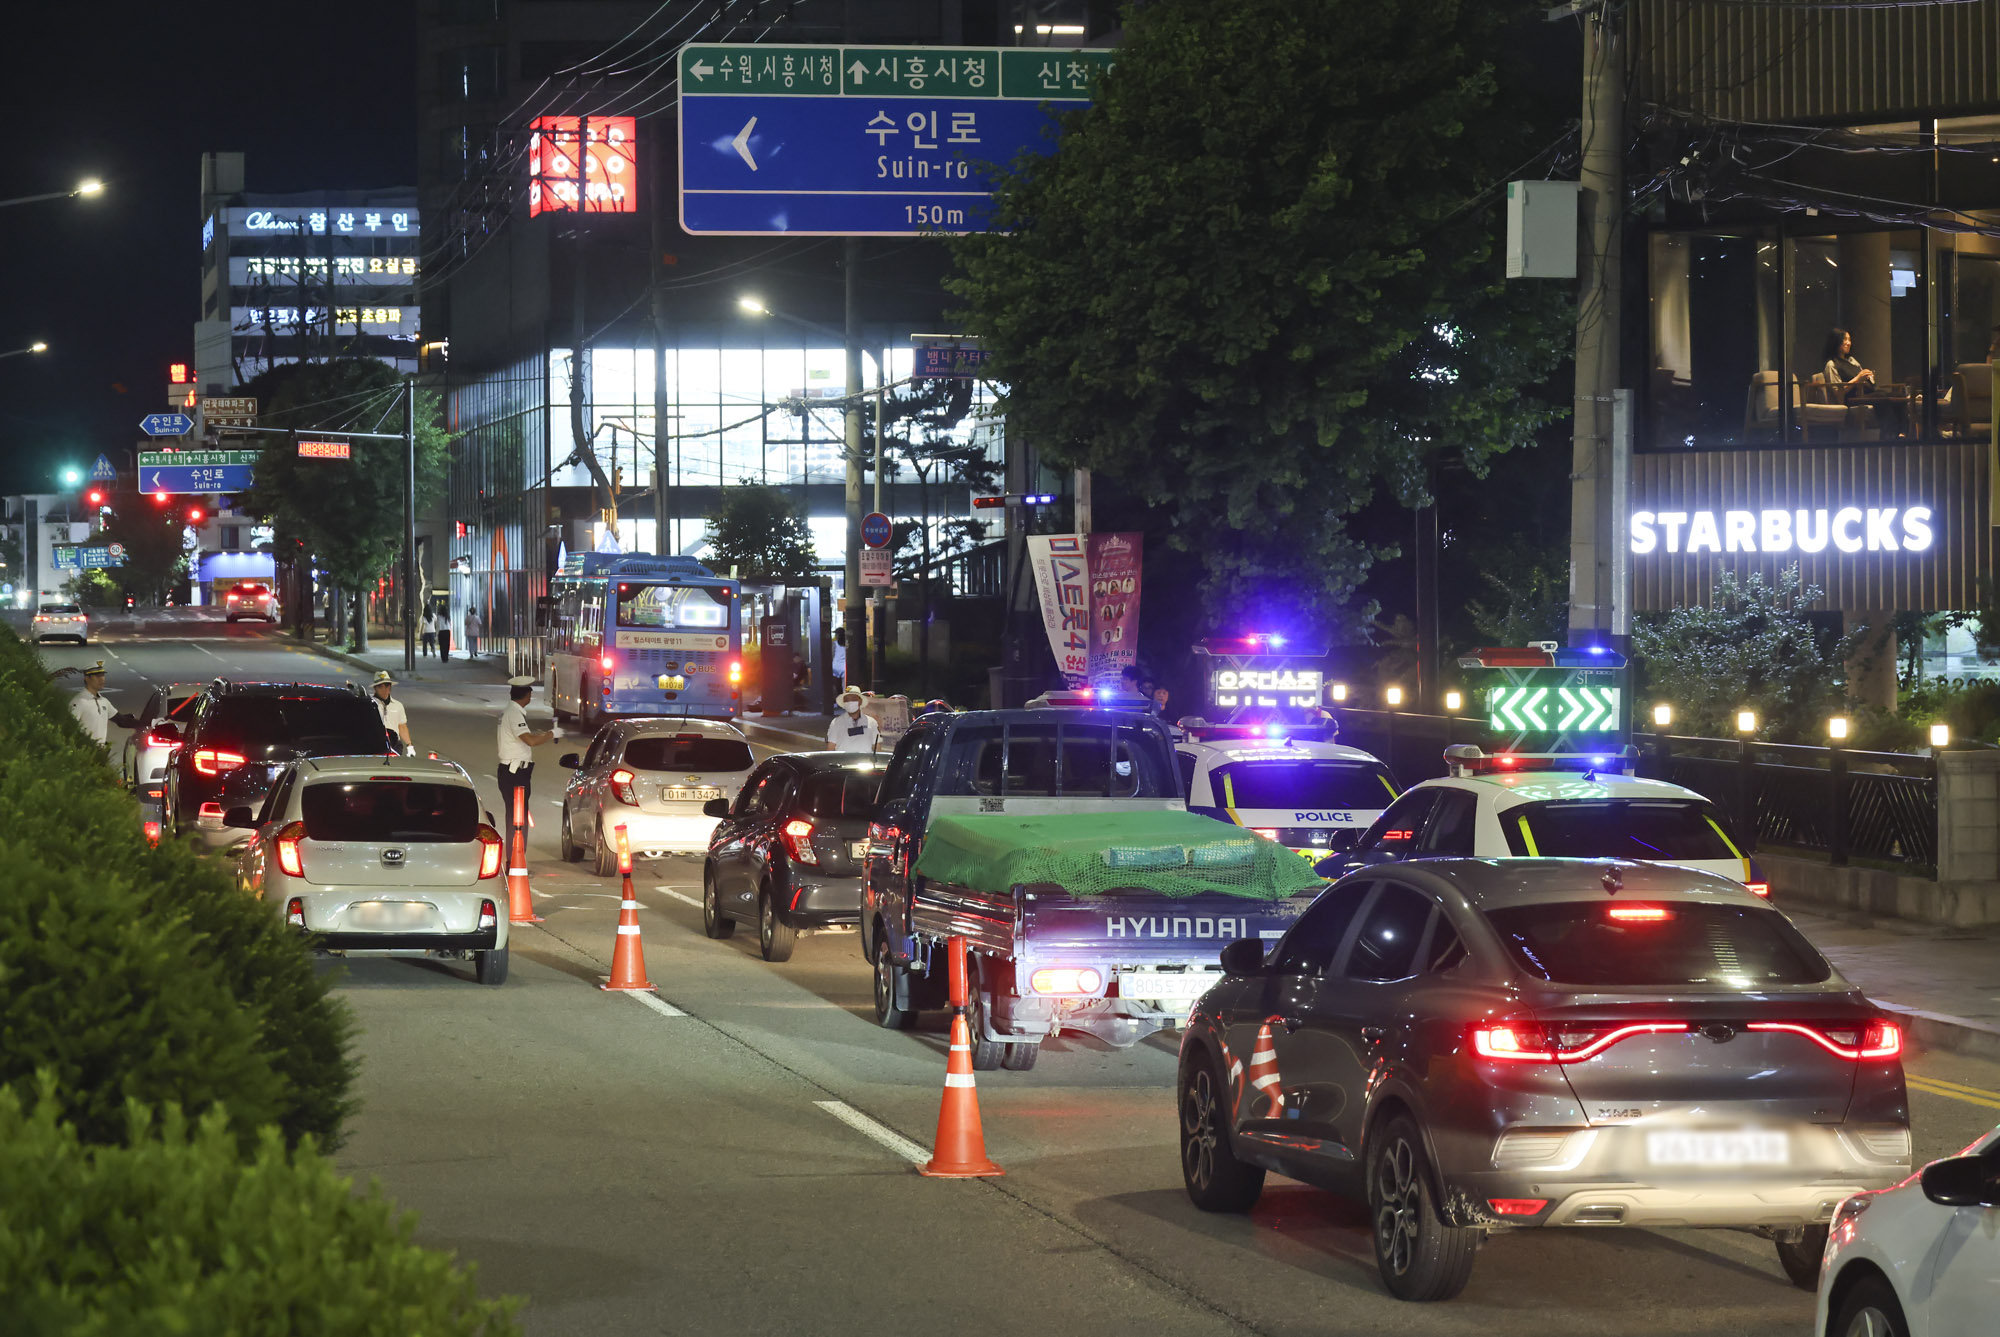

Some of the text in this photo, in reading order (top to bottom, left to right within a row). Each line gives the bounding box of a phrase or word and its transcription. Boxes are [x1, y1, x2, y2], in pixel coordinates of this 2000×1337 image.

[720, 55, 833, 87] 수원,시흥시청
[875, 56, 986, 90] 시흥시청
[1038, 61, 1116, 90] 신천
[865, 110, 981, 149] 수인로
[877, 156, 968, 179] Suin-ro
[309, 213, 420, 231] 참산부인
[905, 205, 963, 225] 150m
[151, 416, 183, 427] 수인로
[299, 443, 350, 456] 시험운영중입니다
[194, 454, 226, 464] 시흥시청
[240, 454, 260, 463] 신천
[191, 469, 224, 481] 수인로
[194, 481, 221, 489] Suin-ro
[1631, 506, 1932, 553] STARBUCKS
[698, 665, 716, 673] BUS
[692, 790, 715, 800] 1342
[1295, 812, 1354, 822] POLICE
[1106, 916, 1247, 939] HYUNDAI
